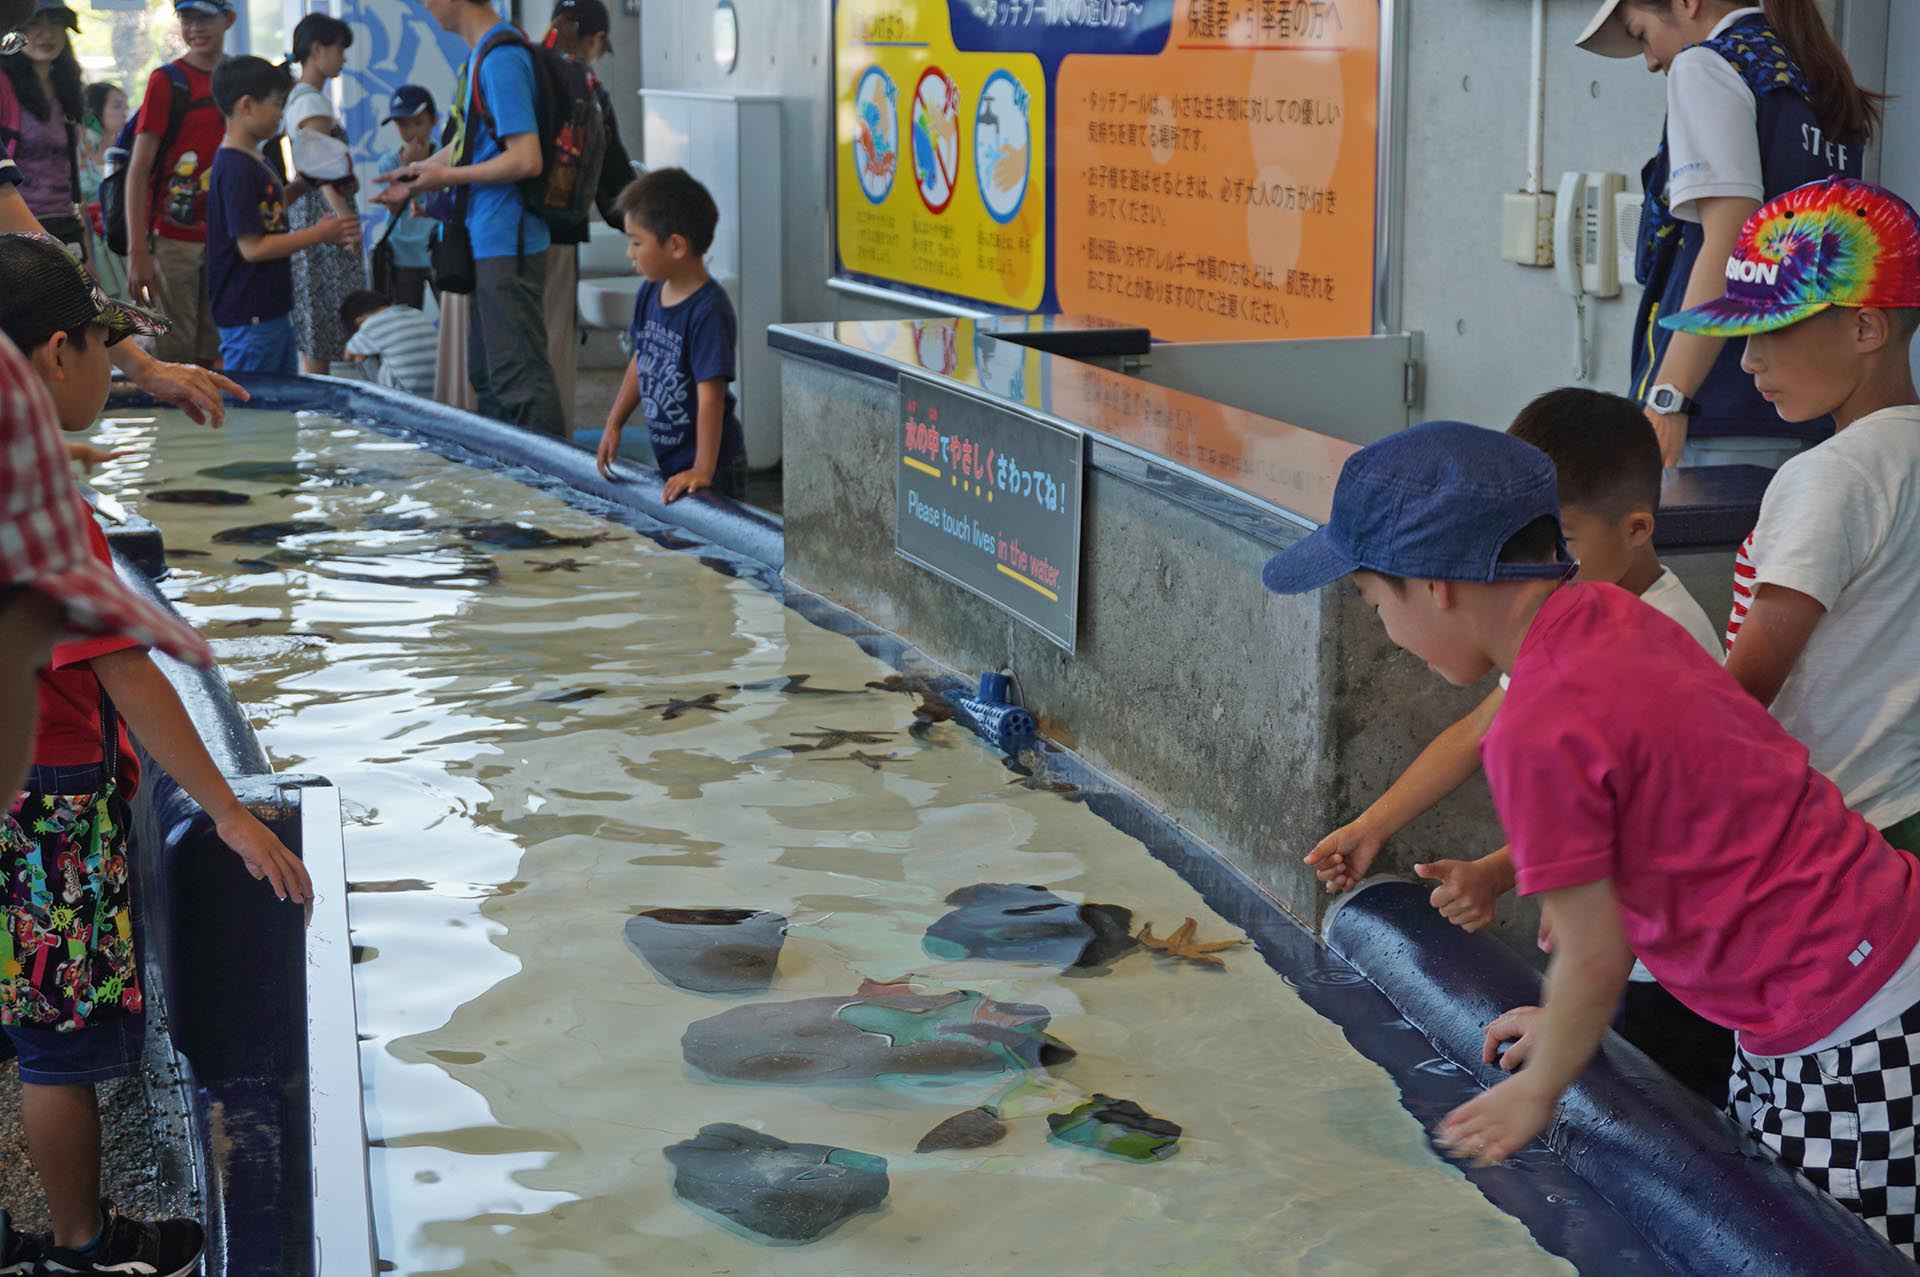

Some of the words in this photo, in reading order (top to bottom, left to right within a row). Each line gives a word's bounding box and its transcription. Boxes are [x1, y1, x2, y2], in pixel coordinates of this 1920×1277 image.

[1801, 122, 1848, 171] STFF
[907, 489, 940, 527] Please
[942, 511, 970, 543] touch
[973, 519, 996, 555] lives
[997, 532, 1008, 559] in
[1009, 539, 1028, 571] the
